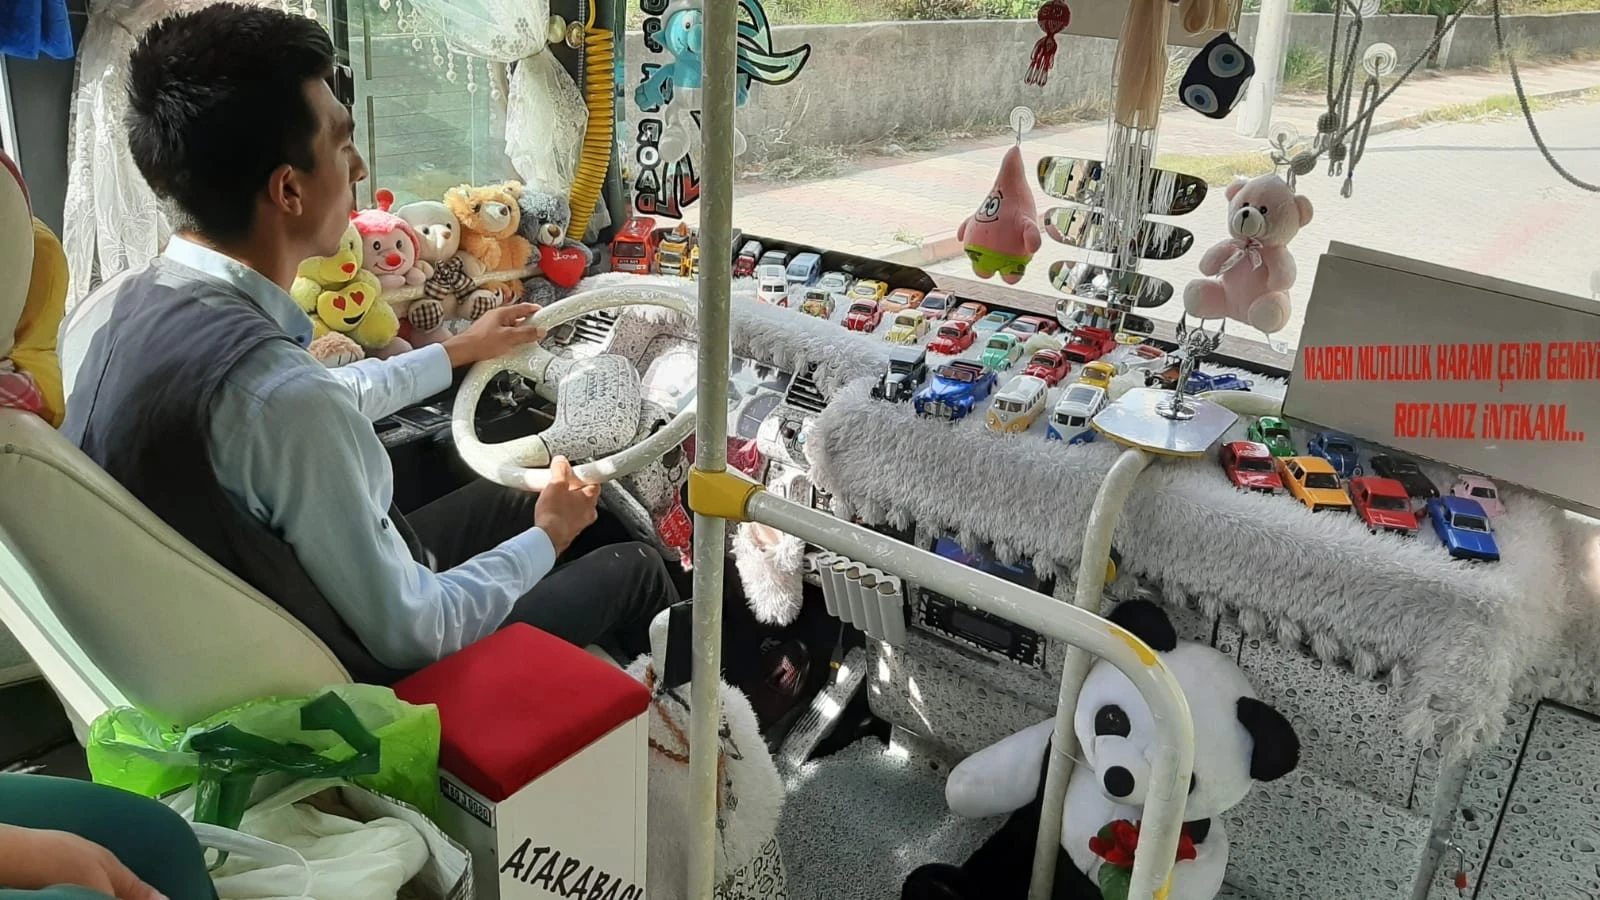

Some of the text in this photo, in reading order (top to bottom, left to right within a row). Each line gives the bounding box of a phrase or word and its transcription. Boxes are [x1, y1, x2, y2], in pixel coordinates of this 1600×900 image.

[1304, 346, 1353, 380] MADEM
[1357, 345, 1432, 380] MUTLULUK
[1436, 343, 1493, 381] HARAM
[1394, 403, 1477, 438] ROTAMIZ
